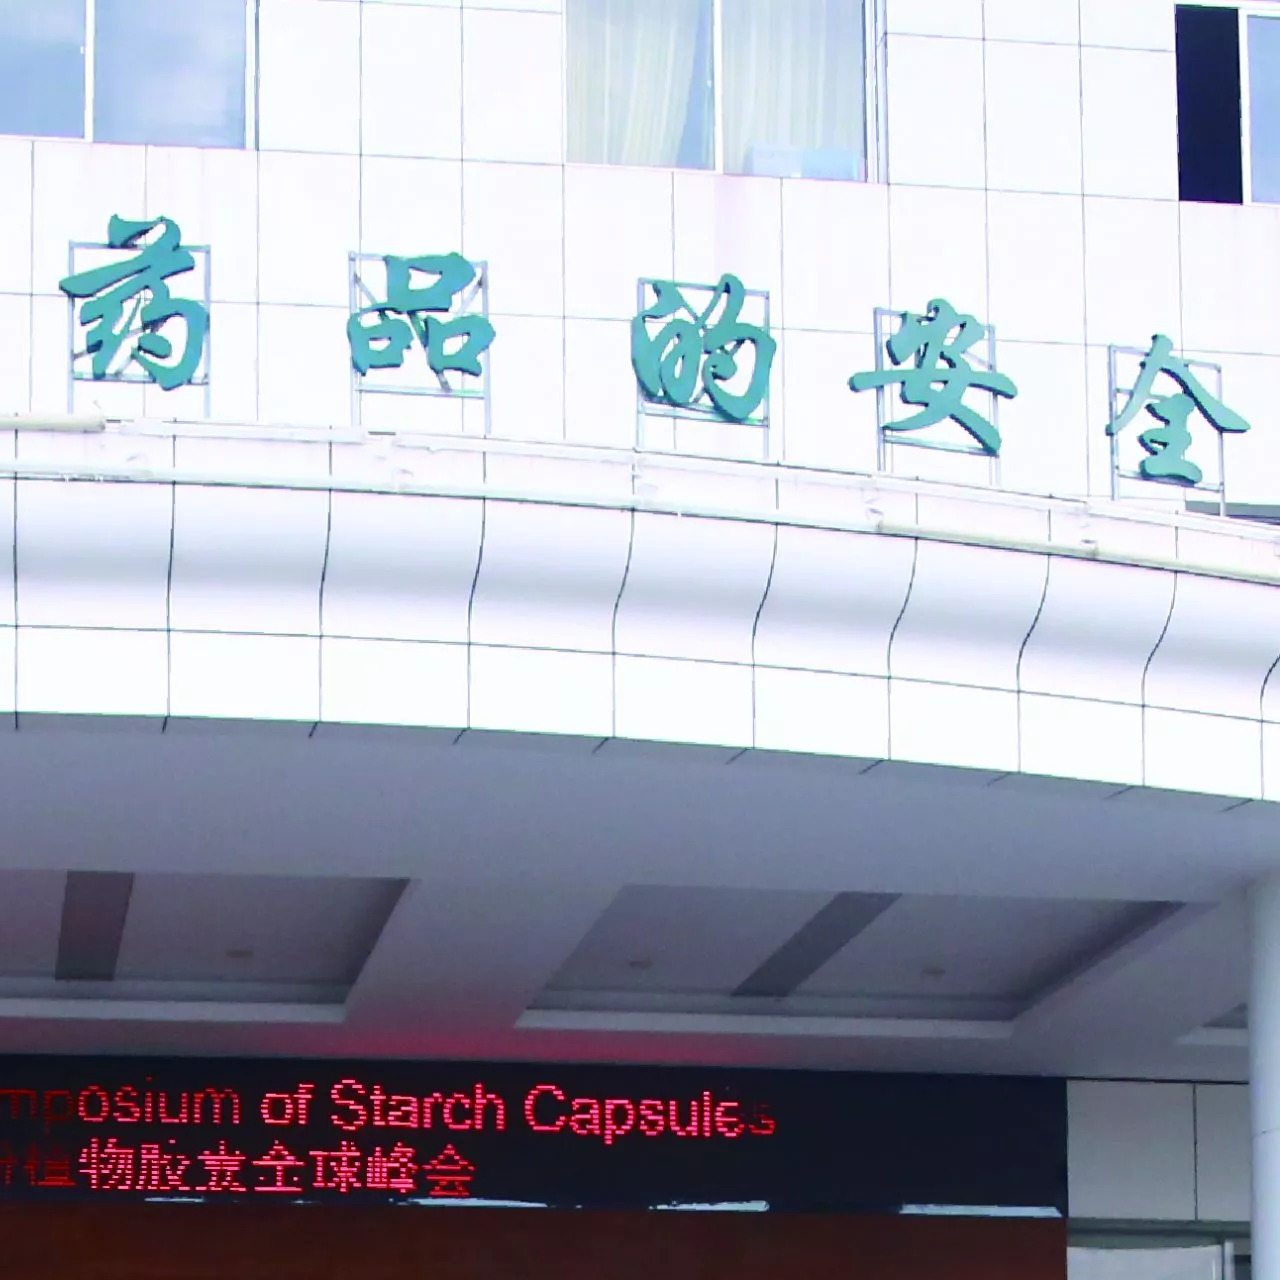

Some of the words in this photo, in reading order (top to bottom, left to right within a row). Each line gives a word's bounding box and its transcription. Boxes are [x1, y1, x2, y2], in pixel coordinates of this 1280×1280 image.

[260, 1083, 316, 1125] of
[330, 1079, 505, 1131] Starch
[524, 1084, 776, 1145] Capsules
